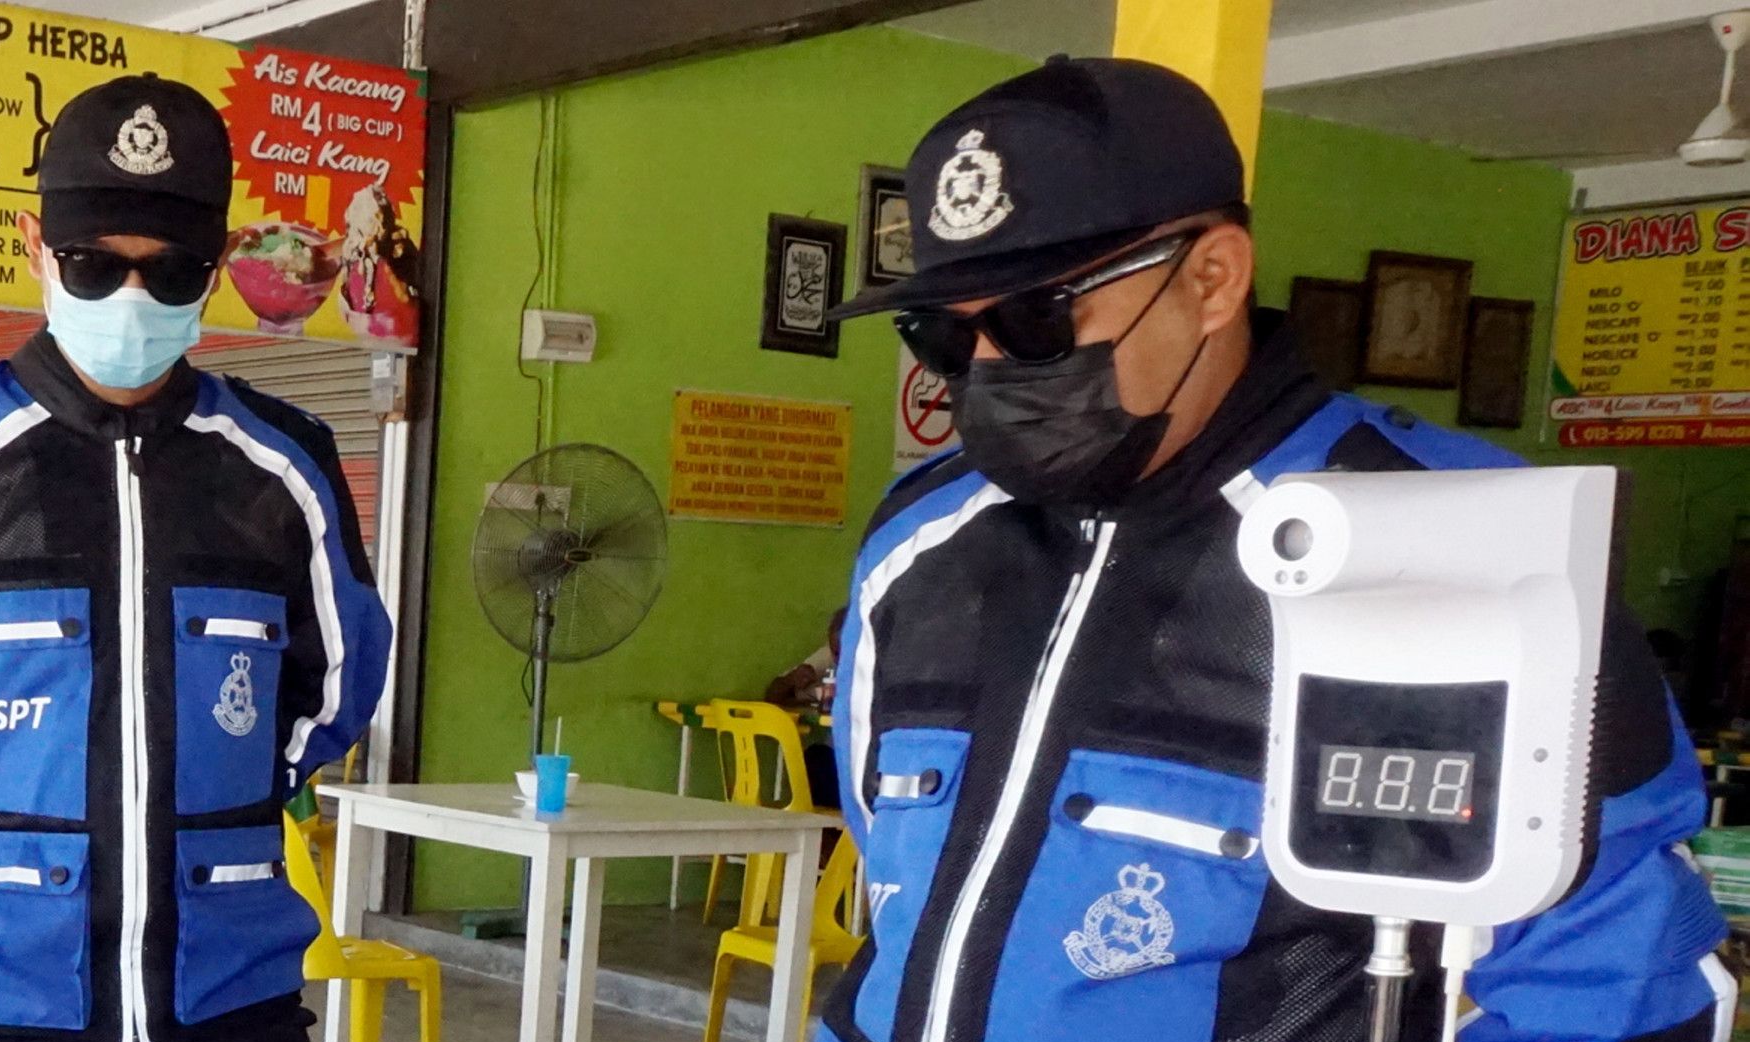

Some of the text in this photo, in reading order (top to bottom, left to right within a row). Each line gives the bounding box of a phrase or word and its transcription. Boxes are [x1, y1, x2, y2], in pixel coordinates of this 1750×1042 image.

[29, 22, 128, 69] HERBA
[254, 53, 406, 112] Ais Kacang
[337, 114, 362, 132] BIG
[365, 118, 394, 136] CUP
[250, 130, 390, 186] Laici Kang
[275, 171, 306, 196] RM
[1575, 206, 1750, 264] DIANA S
